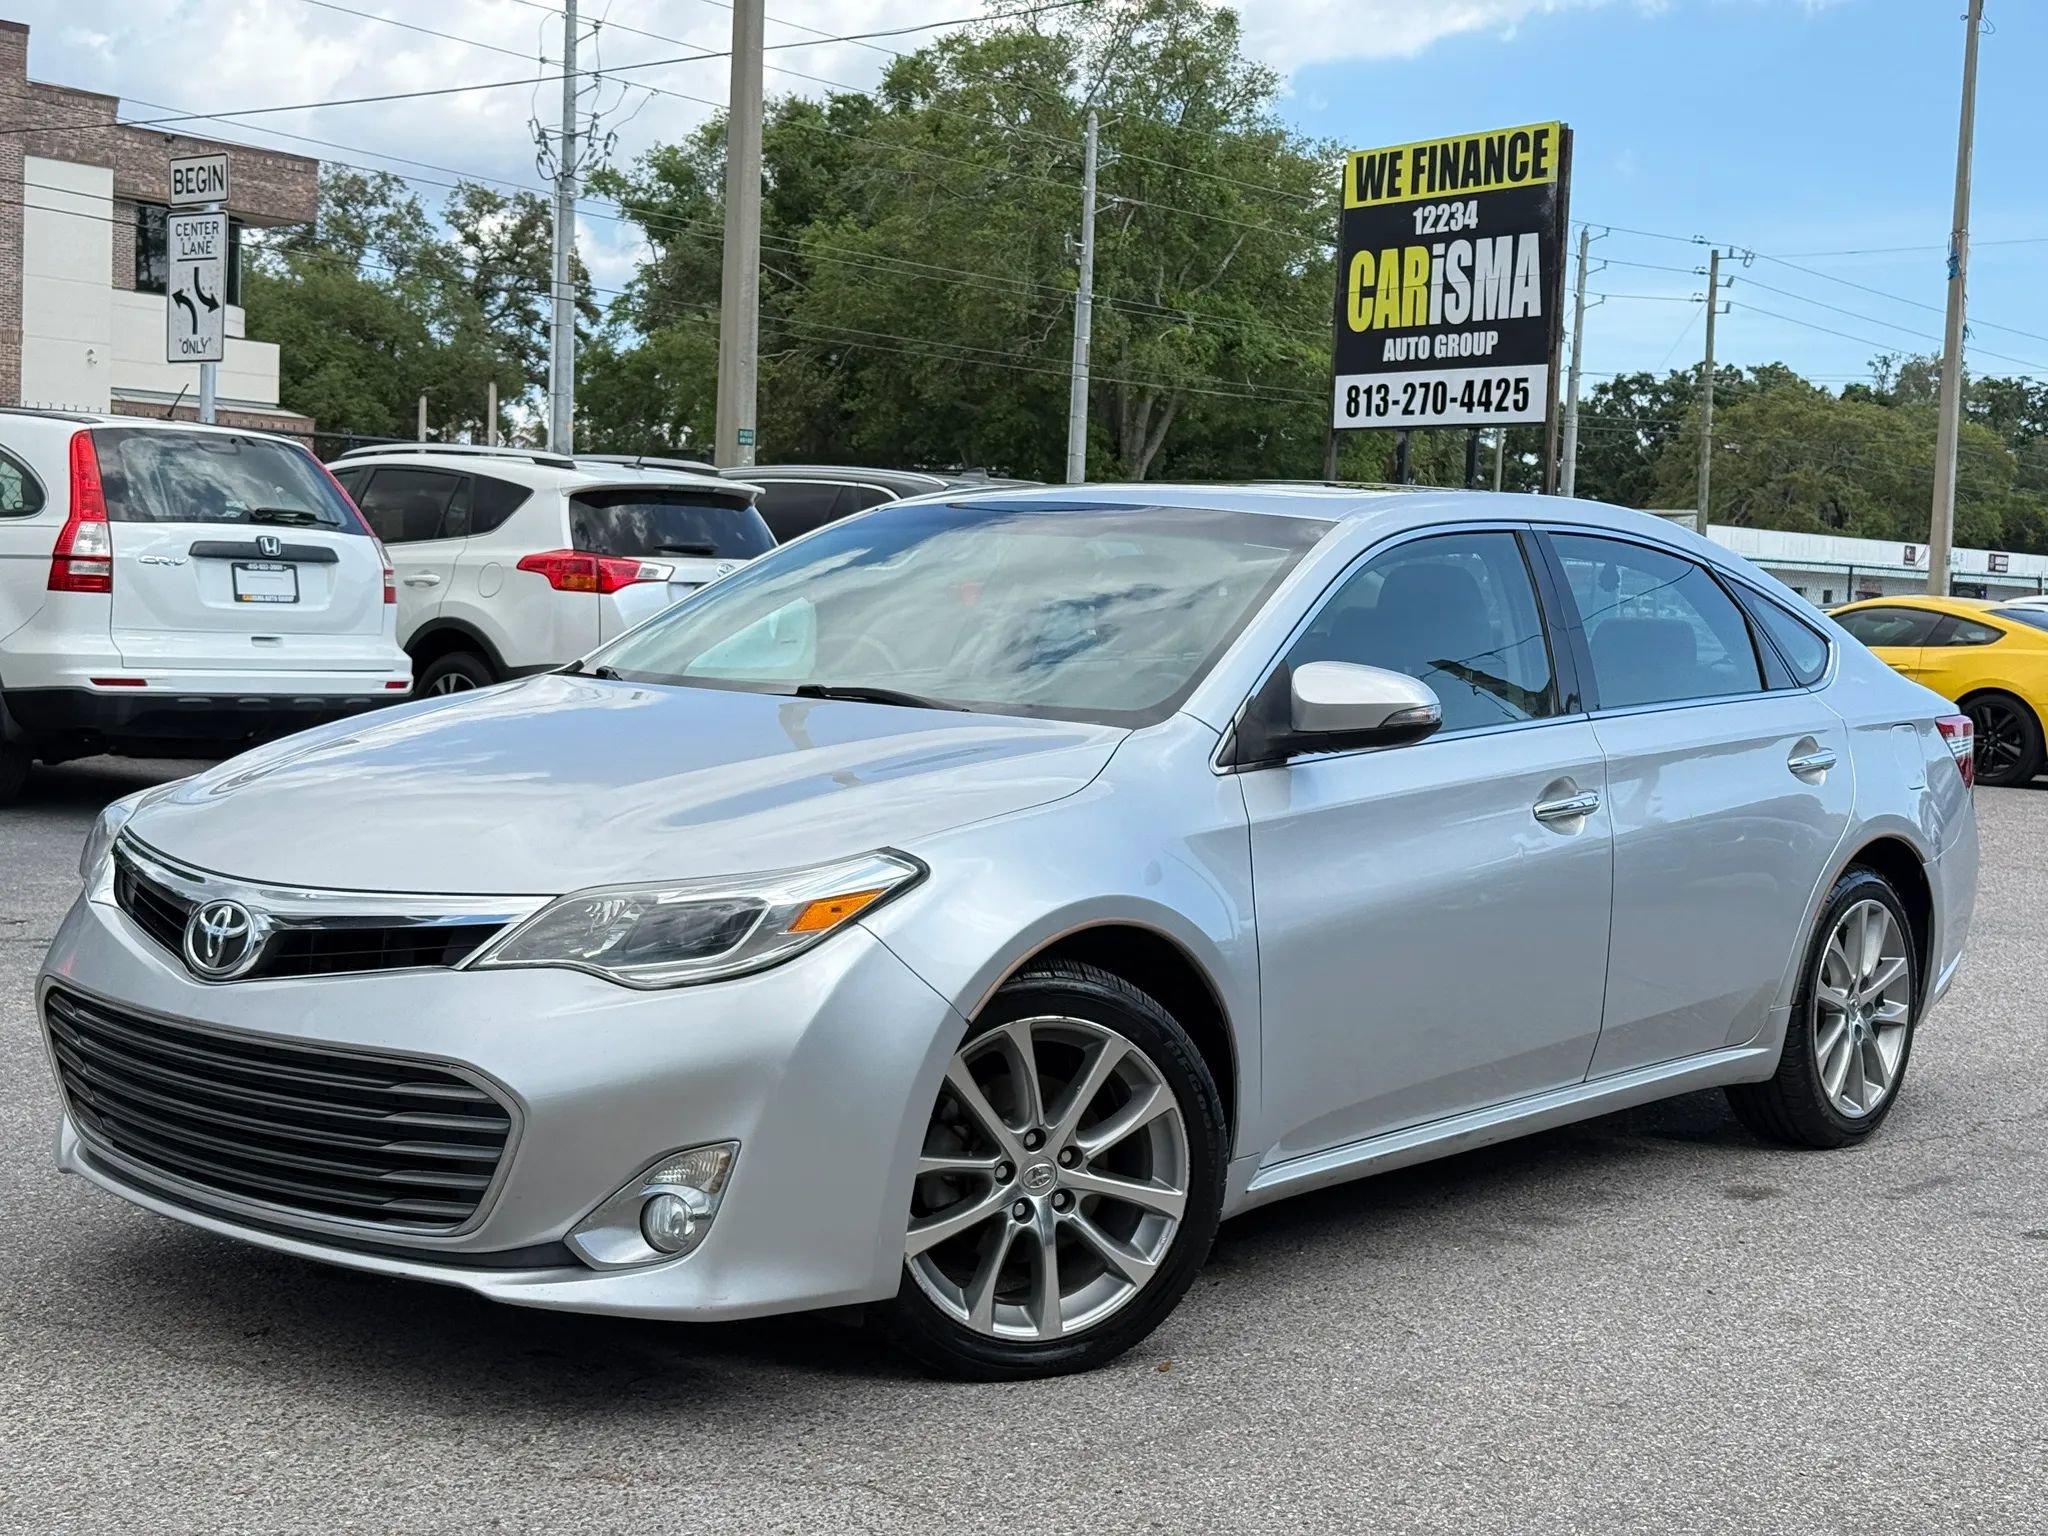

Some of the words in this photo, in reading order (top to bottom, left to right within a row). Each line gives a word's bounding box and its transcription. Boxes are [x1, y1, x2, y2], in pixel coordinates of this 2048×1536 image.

[173, 164, 225, 195] BEGIN
[1356, 151, 1403, 202] WE
[1411, 128, 1549, 195] FINANCE
[175, 221, 219, 236] CENTER
[1412, 200, 1479, 236] 12234
[182, 240, 212, 256] LANE
[181, 337, 209, 354] ONLY
[1382, 335, 1431, 363] AUTO
[1434, 331, 1499, 359] GROUP
[1346, 377, 1530, 418] 813-270-4425
